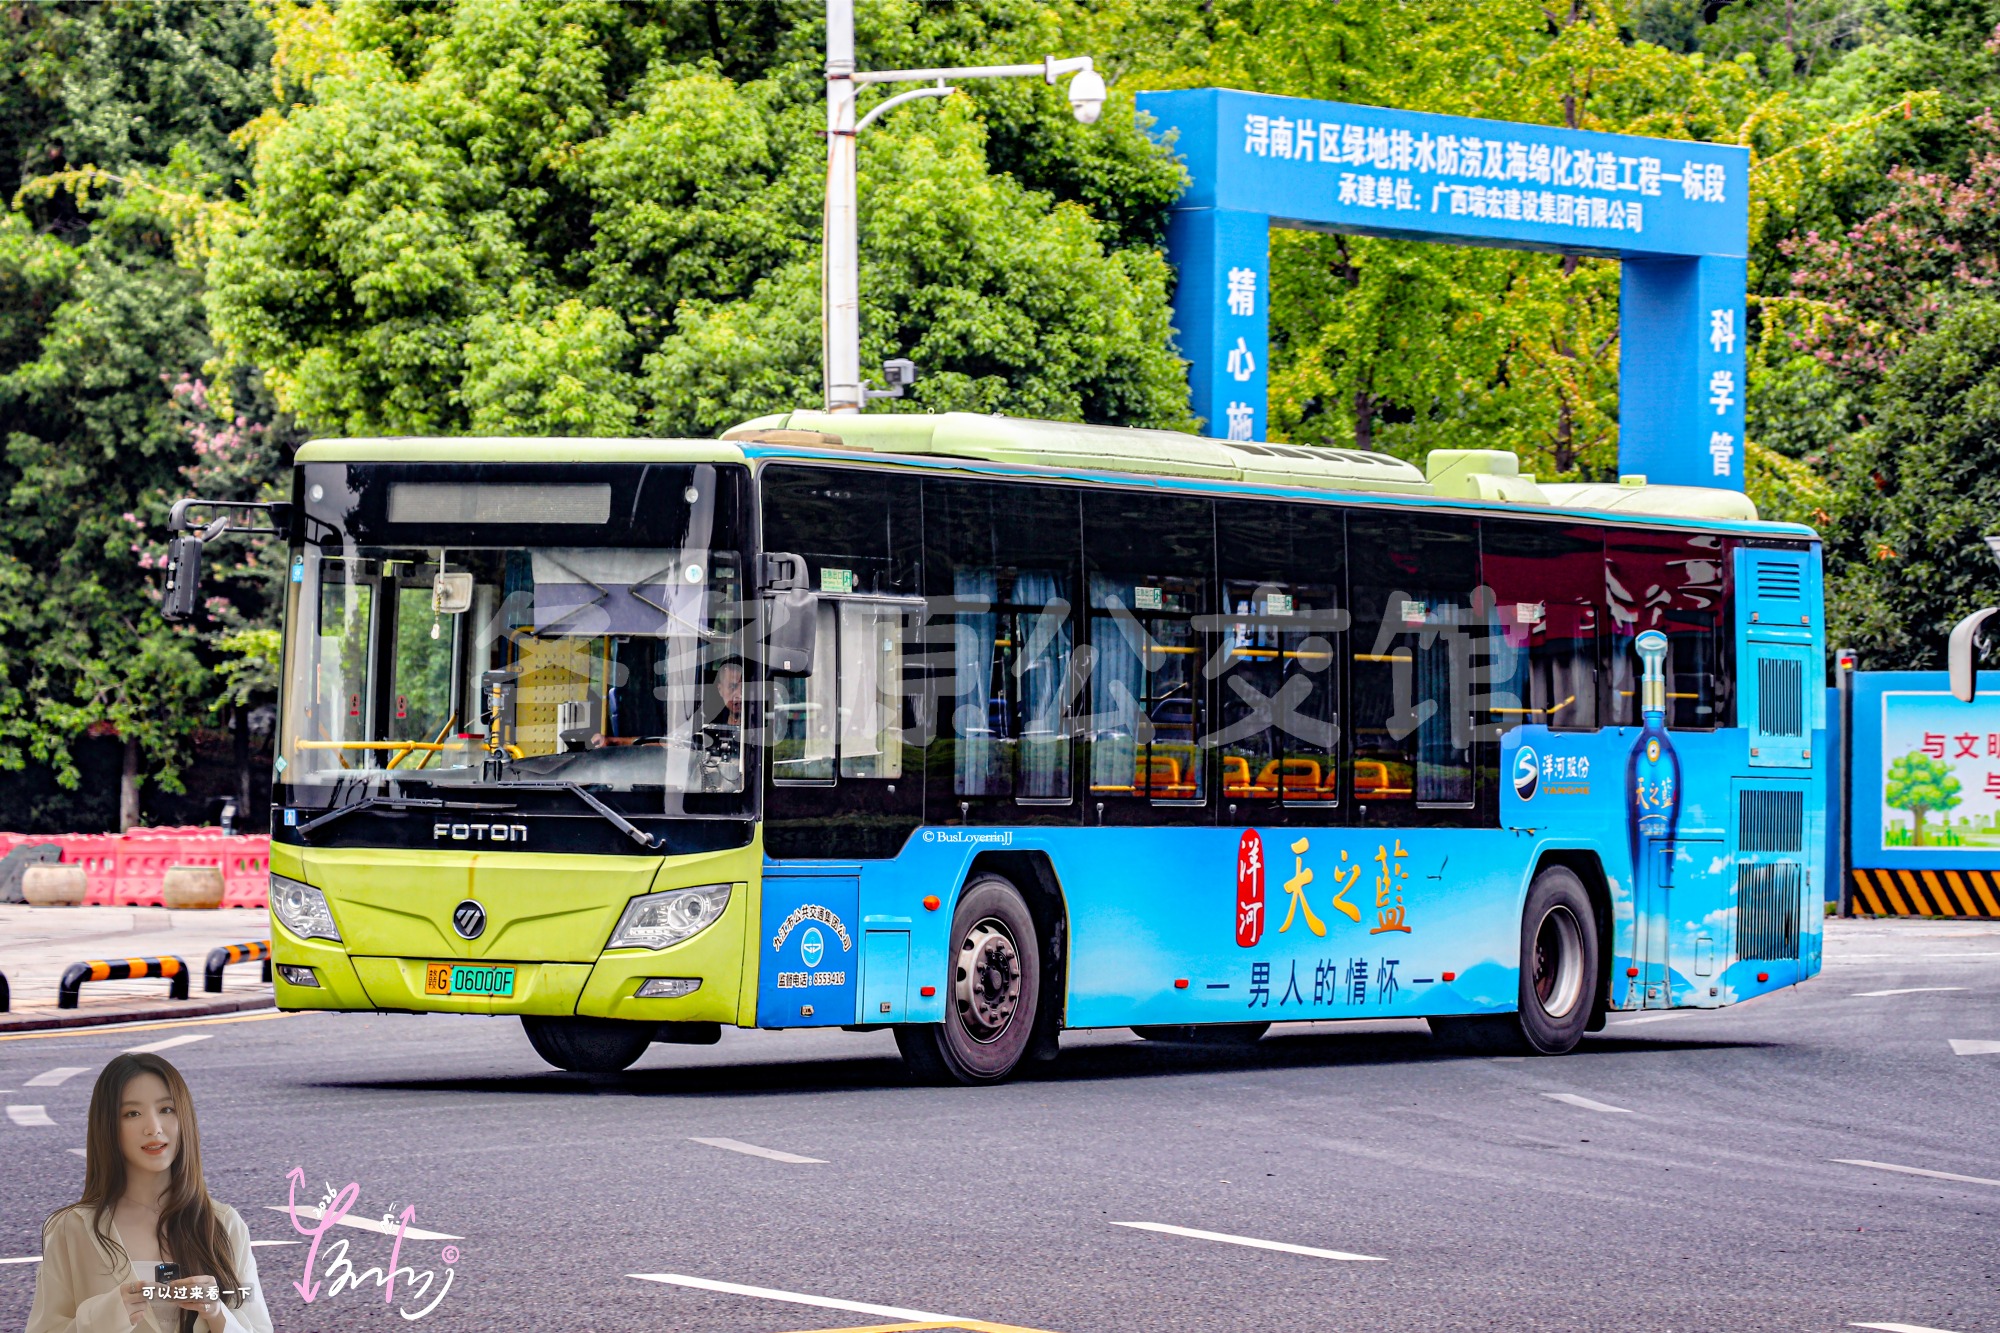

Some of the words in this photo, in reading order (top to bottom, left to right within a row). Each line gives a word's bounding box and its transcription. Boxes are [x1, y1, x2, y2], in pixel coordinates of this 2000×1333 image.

[1244, 114, 1726, 203] 浔南片区绿地排水防涝及海绵化改造工程一标段
[1709, 309, 1736, 477] 科学管
[433, 823, 528, 842] FOTON
[1239, 837, 1264, 943] 洋河
[773, 904, 852, 952] 九江市公共交通集团公司
[1248, 957, 1400, 1009] 男人的情怀
